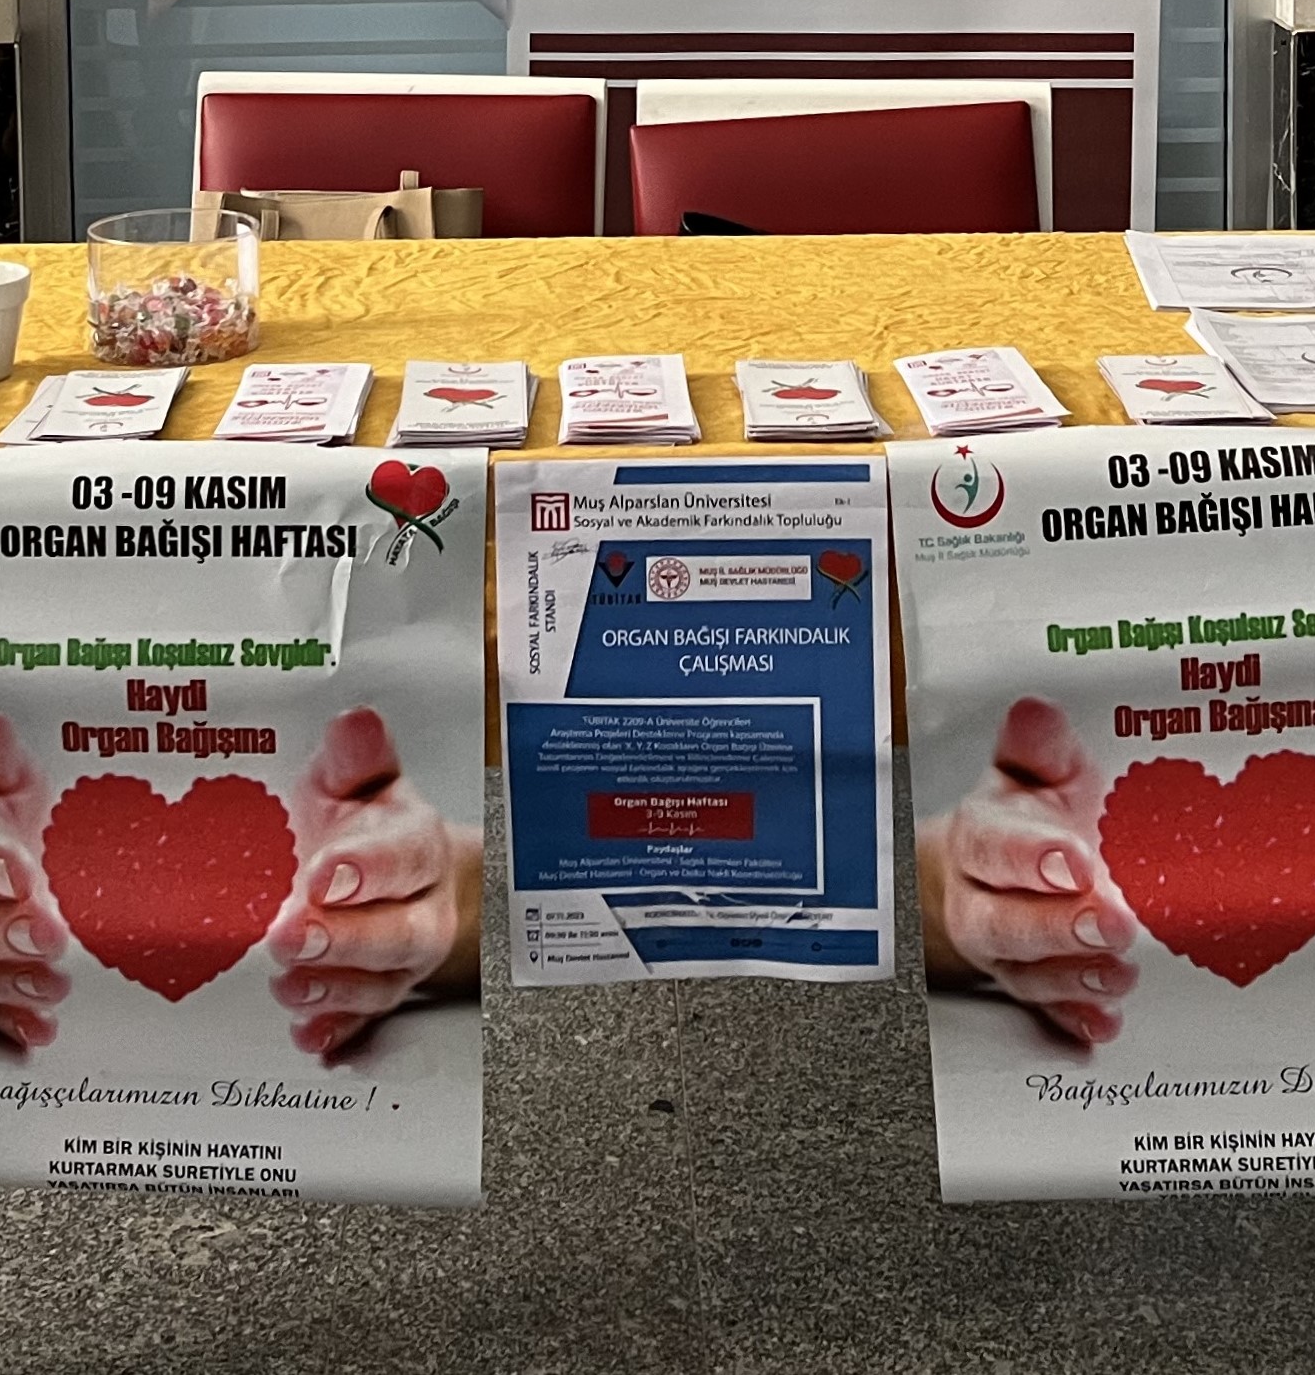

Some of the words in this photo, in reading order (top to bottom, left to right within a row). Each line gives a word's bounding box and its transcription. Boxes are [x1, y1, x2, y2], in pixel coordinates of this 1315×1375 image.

[1108, 454, 1150, 489] 03
[1157, 449, 1211, 486] -09
[71, 476, 113, 510] 03
[121, 476, 177, 510] -09
[185, 476, 287, 510] KASIM
[573, 496, 605, 512] Muş
[609, 495, 680, 511] Alparslan
[684, 492, 772, 509] Üniversitesi
[573, 515, 615, 530] Sosyal
[617, 518, 633, 527] ve
[636, 514, 701, 527] Akademik
[704, 514, 774, 527] Farkındalık
[777, 513, 843, 529] Topluluğu
[1041, 506, 1150, 542] ORGAN
[1156, 492, 1265, 538] BAĞIŞI
[0, 525, 107, 559] ORGAN
[116, 519, 223, 565] BAĞIŞI
[231, 524, 357, 558] HAFTASI
[937, 535, 971, 548] Sağlık
[528, 550, 539, 627] FARKINDALIK
[545, 590, 556, 633] STANDI
[602, 628, 669, 647] ORGAN
[674, 625, 729, 650] BAĞIŞI
[735, 626, 850, 645] FARKINDALIK
[1047, 623, 1114, 655] Organ
[1118, 616, 1184, 651] Bağışı
[1189, 610, 1286, 646] Koşulsuz
[67, 636, 131, 670] Bağışı
[137, 637, 235, 670] Koşulsuz
[529, 631, 540, 675] SOSYAL
[679, 654, 774, 677] ÇALIŞMASI
[1180, 653, 1261, 693] Haydi
[126, 679, 207, 719] Haydi
[1114, 703, 1202, 740] Organ
[62, 722, 149, 759] Organ
[156, 720, 277, 760] Bağışına
[614, 797, 647, 809] Organ
[687, 797, 728, 807] Haftası
[210, 1079, 354, 1112] Dikkatine
[1026, 1071, 1275, 1110] Bağışçılarımızın
[64, 1136, 97, 1154] KİM
[103, 1137, 132, 1155] BİR
[138, 1138, 202, 1160] KİŞİNİN
[207, 1144, 282, 1160] HAYATINI
[1134, 1133, 1168, 1151] KİM
[1174, 1132, 1204, 1150] BİR
[1210, 1130, 1276, 1153] KİŞİNİN
[49, 1161, 157, 1178] KURTARMAK
[163, 1162, 255, 1182] SURETİYLE
[260, 1167, 297, 1183] ONU
[1120, 1157, 1233, 1173] KURTARMAK
[1119, 1180, 1214, 1192] YAŞATIRSA
[1219, 1175, 1279, 1190] BÜTÜN
